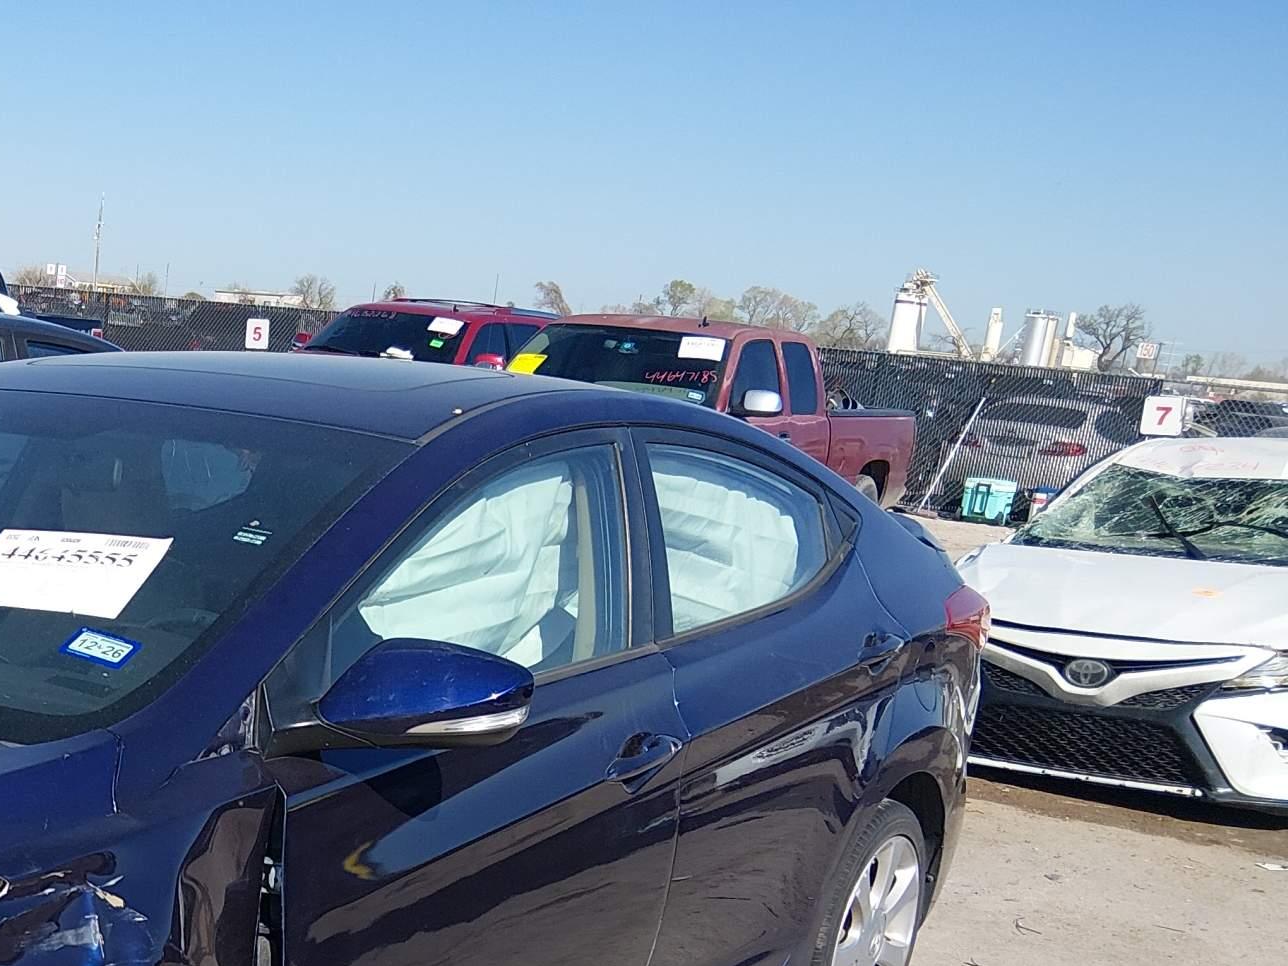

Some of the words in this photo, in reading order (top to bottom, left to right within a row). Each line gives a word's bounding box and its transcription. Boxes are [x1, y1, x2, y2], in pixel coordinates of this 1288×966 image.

[252, 326, 263, 342] 5
[644, 370, 718, 384] 44647185
[1155, 406, 1173, 426] 7
[0, 546, 139, 568] 44645555
